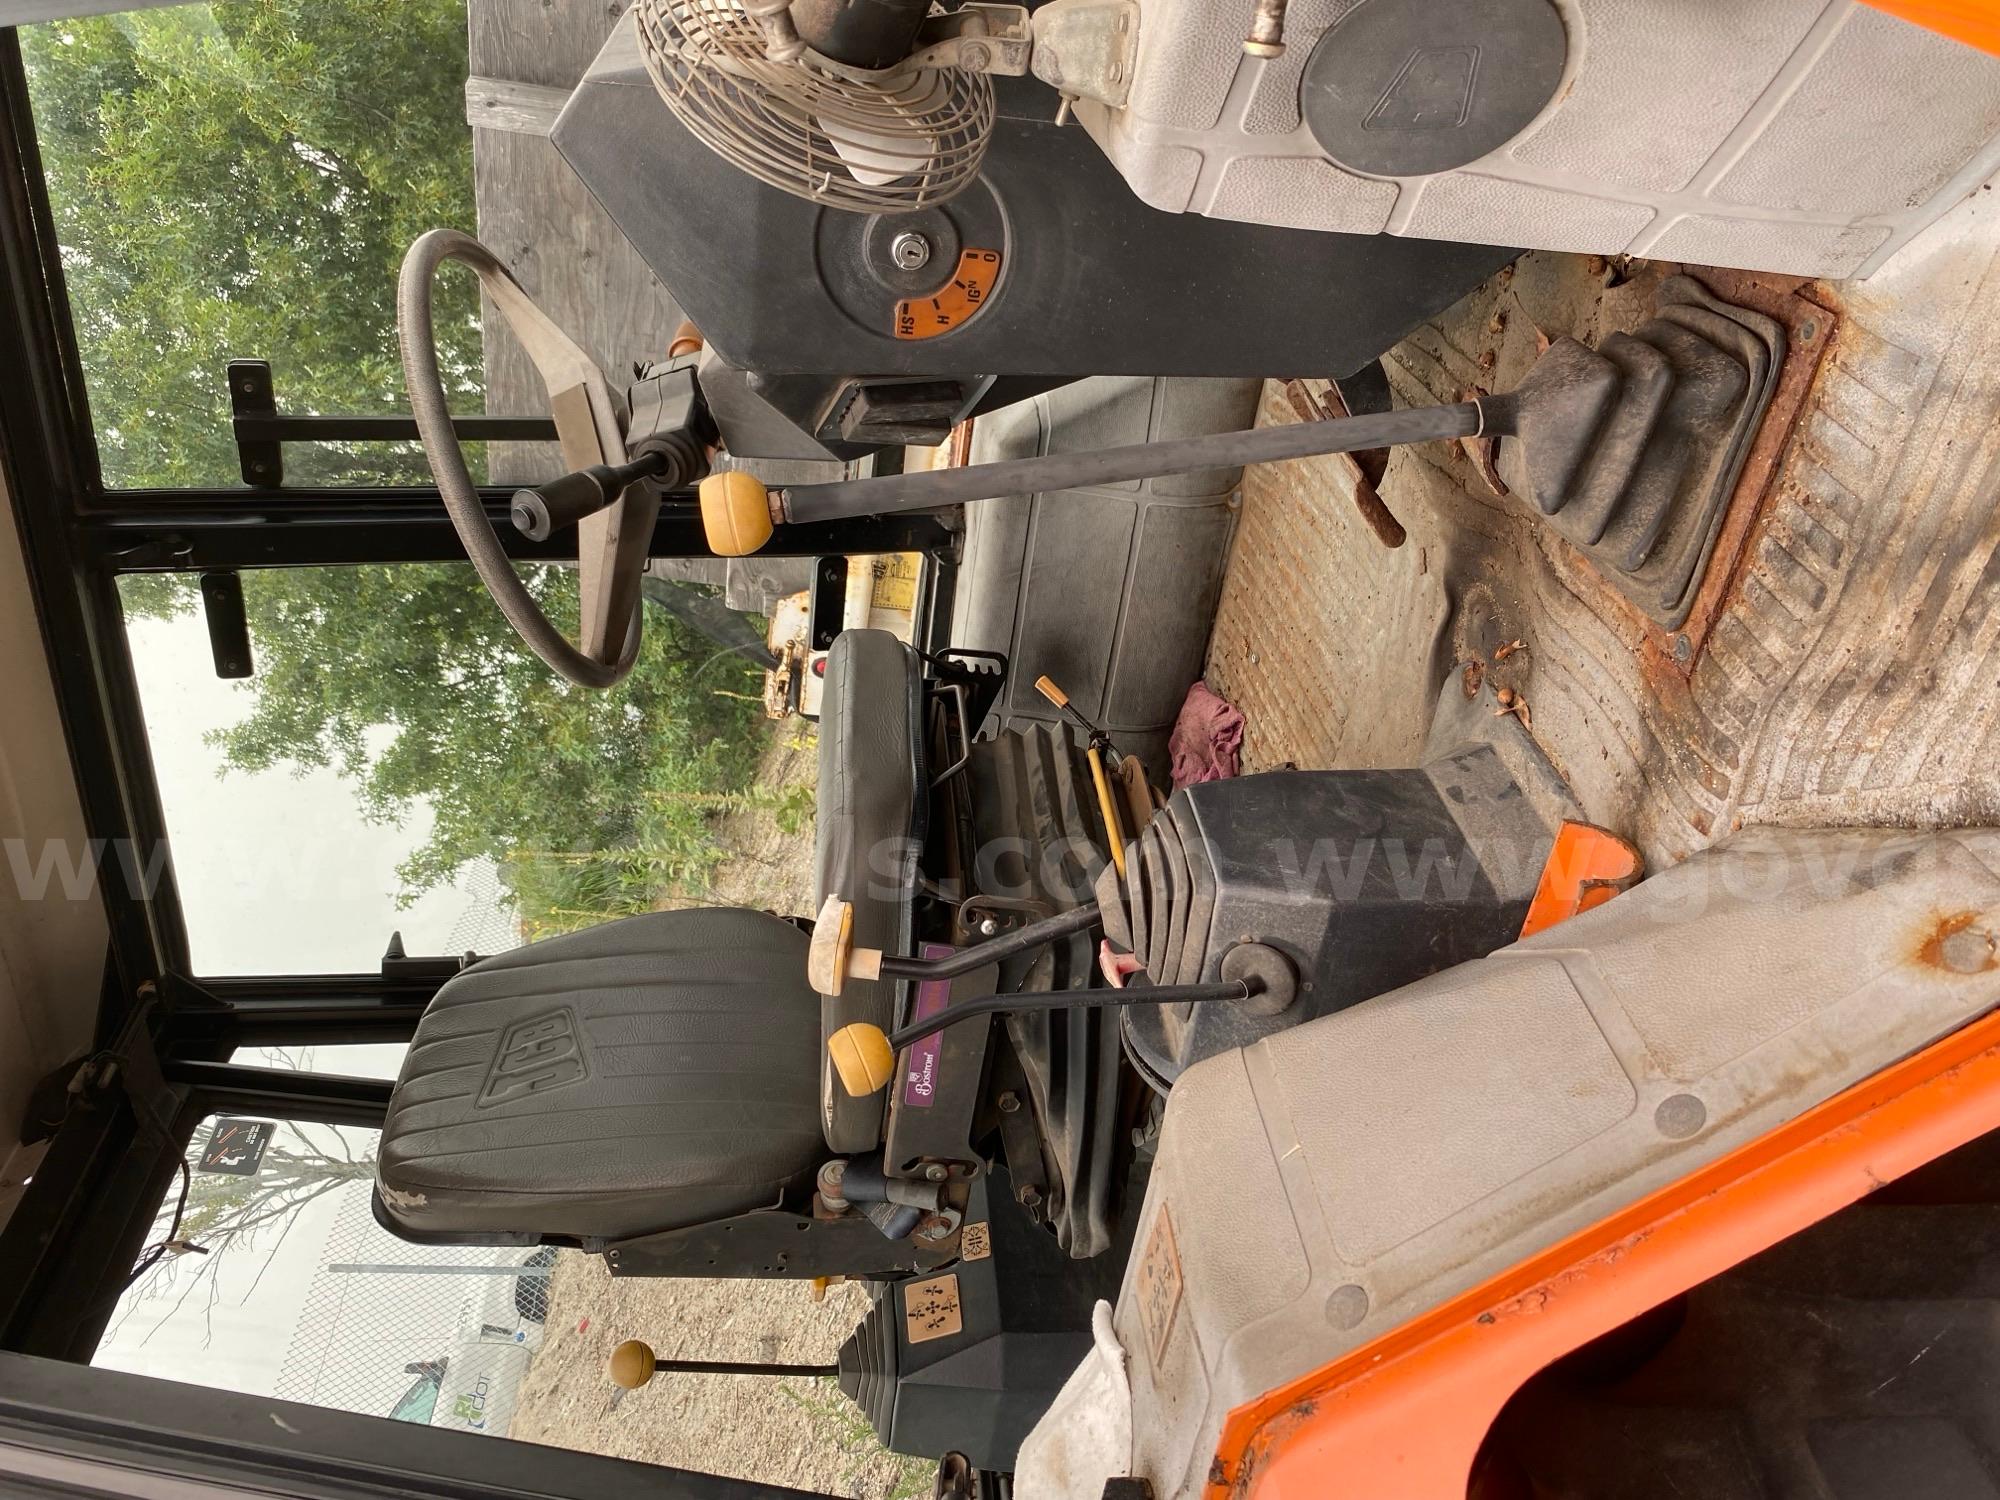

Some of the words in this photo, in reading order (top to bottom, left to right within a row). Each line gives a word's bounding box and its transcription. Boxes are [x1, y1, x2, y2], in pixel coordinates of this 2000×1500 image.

[900, 316, 914, 335] HS
[937, 315, 949, 325] H
[485, 1012, 581, 1100] JCB
[914, 1052, 934, 1096] Bostrom
